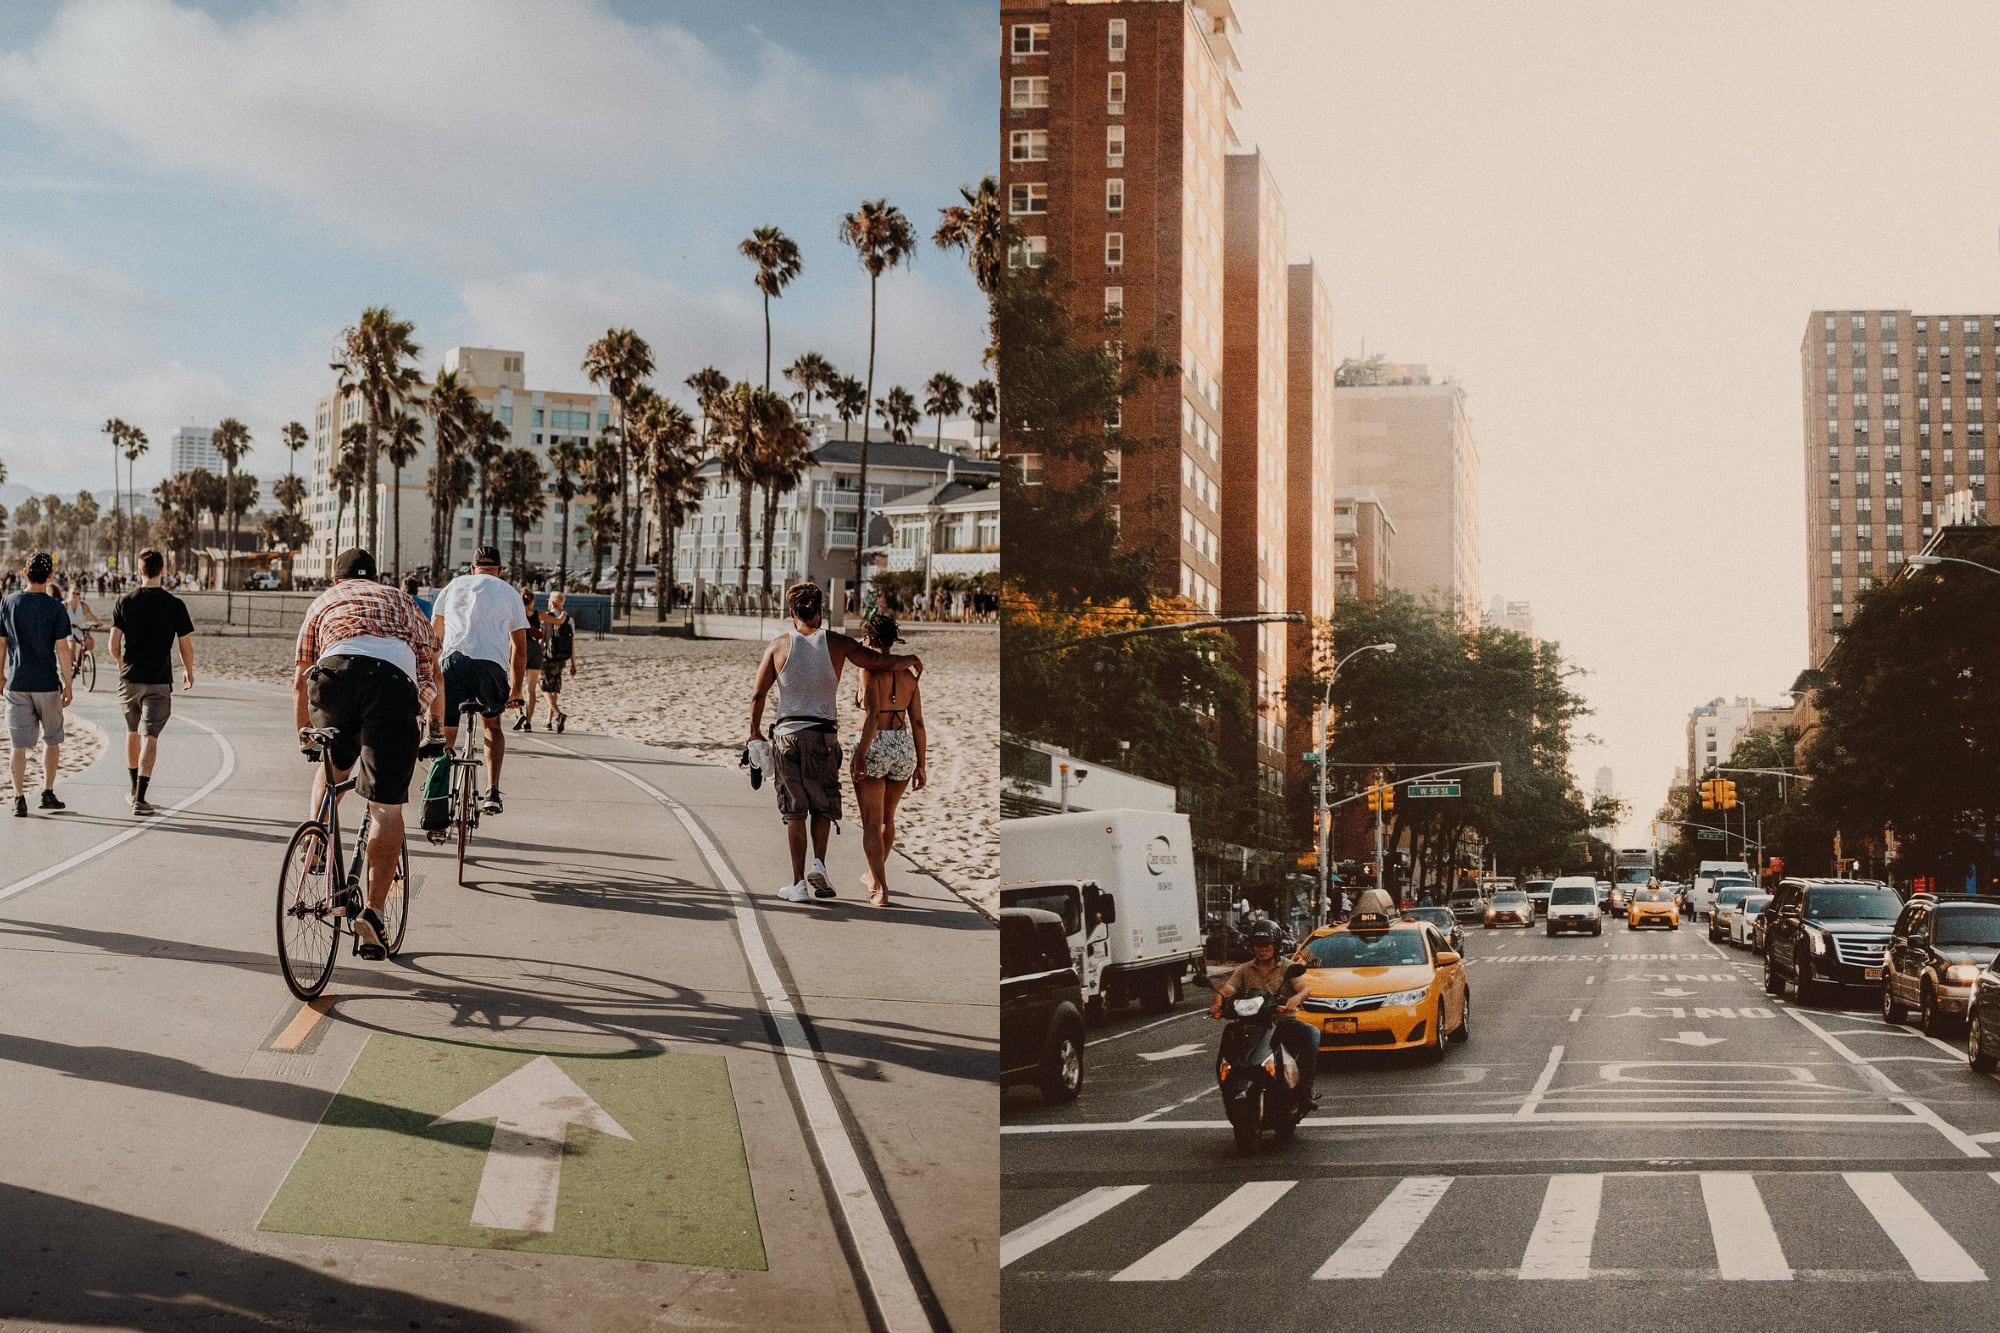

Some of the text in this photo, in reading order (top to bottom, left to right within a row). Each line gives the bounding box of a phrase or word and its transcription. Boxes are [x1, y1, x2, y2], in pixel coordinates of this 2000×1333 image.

[1420, 787, 1428, 795] W
[1602, 953, 1722, 961] SCHOOL
[1610, 974, 1737, 982] ONLY
[1606, 1007, 1777, 1019] ONLY
